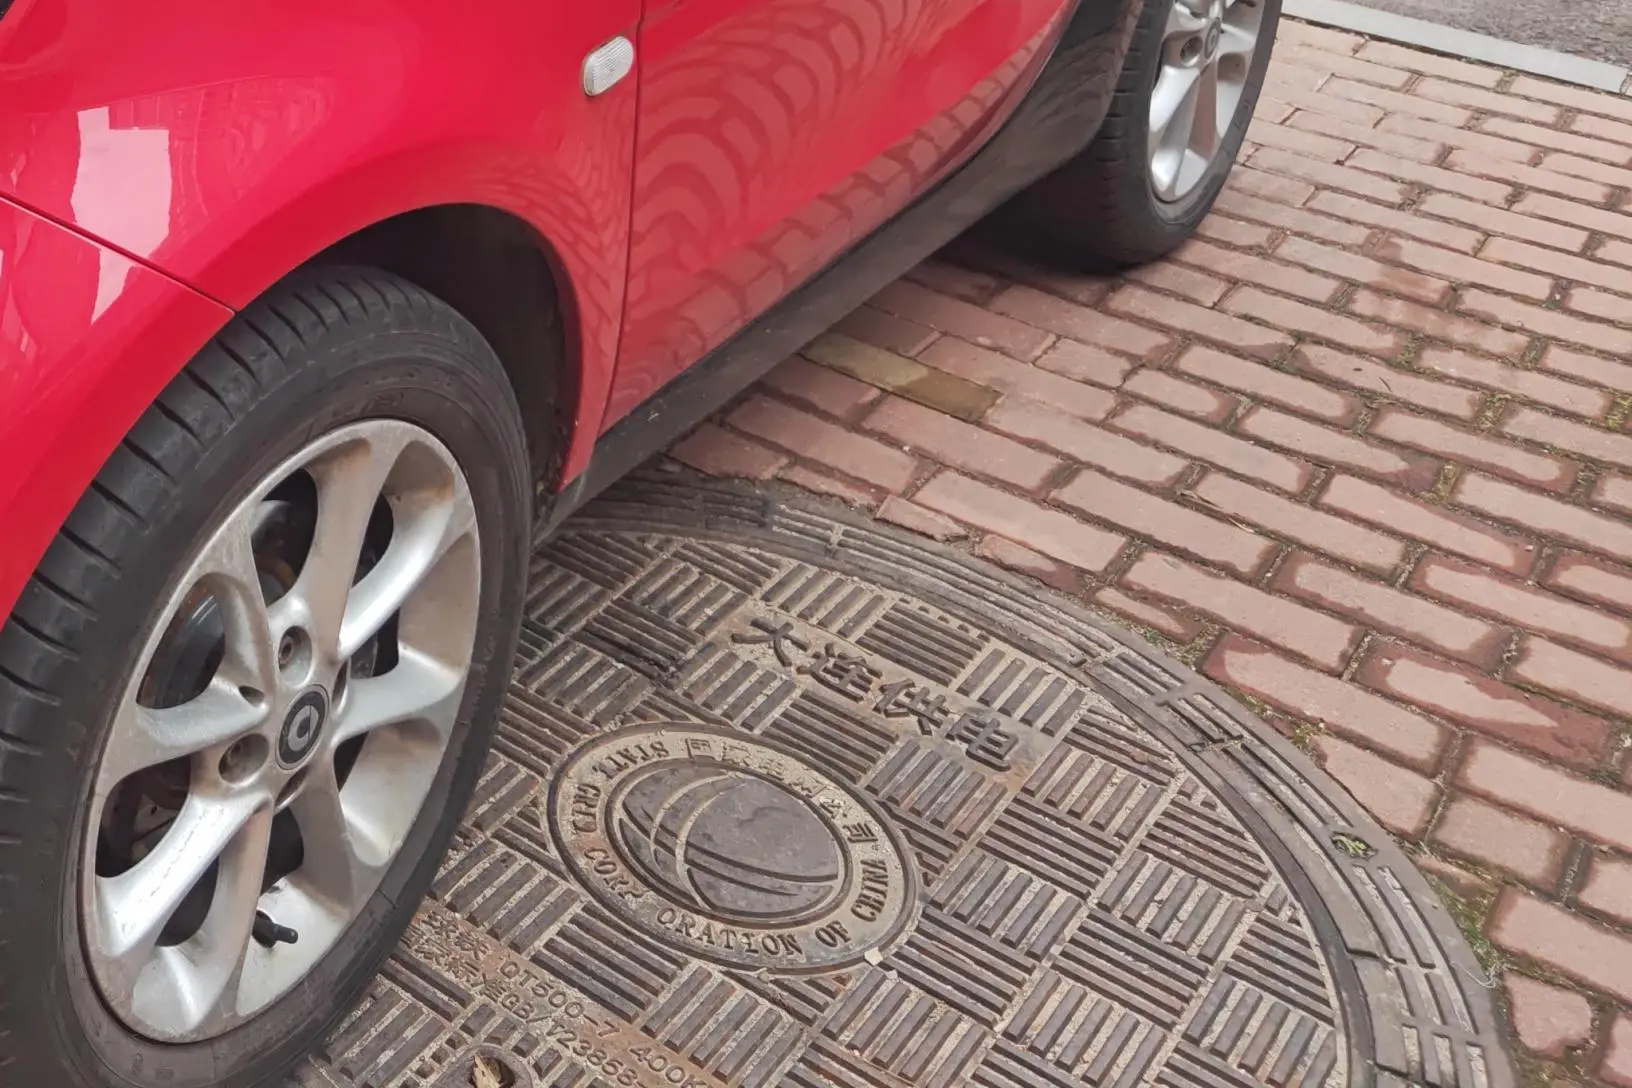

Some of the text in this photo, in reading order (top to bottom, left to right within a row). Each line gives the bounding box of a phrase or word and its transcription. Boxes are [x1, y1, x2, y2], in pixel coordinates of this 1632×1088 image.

[731, 617, 1019, 772] 大连供电
[814, 920, 851, 948] OF
[850, 859, 888, 922] CHINA
